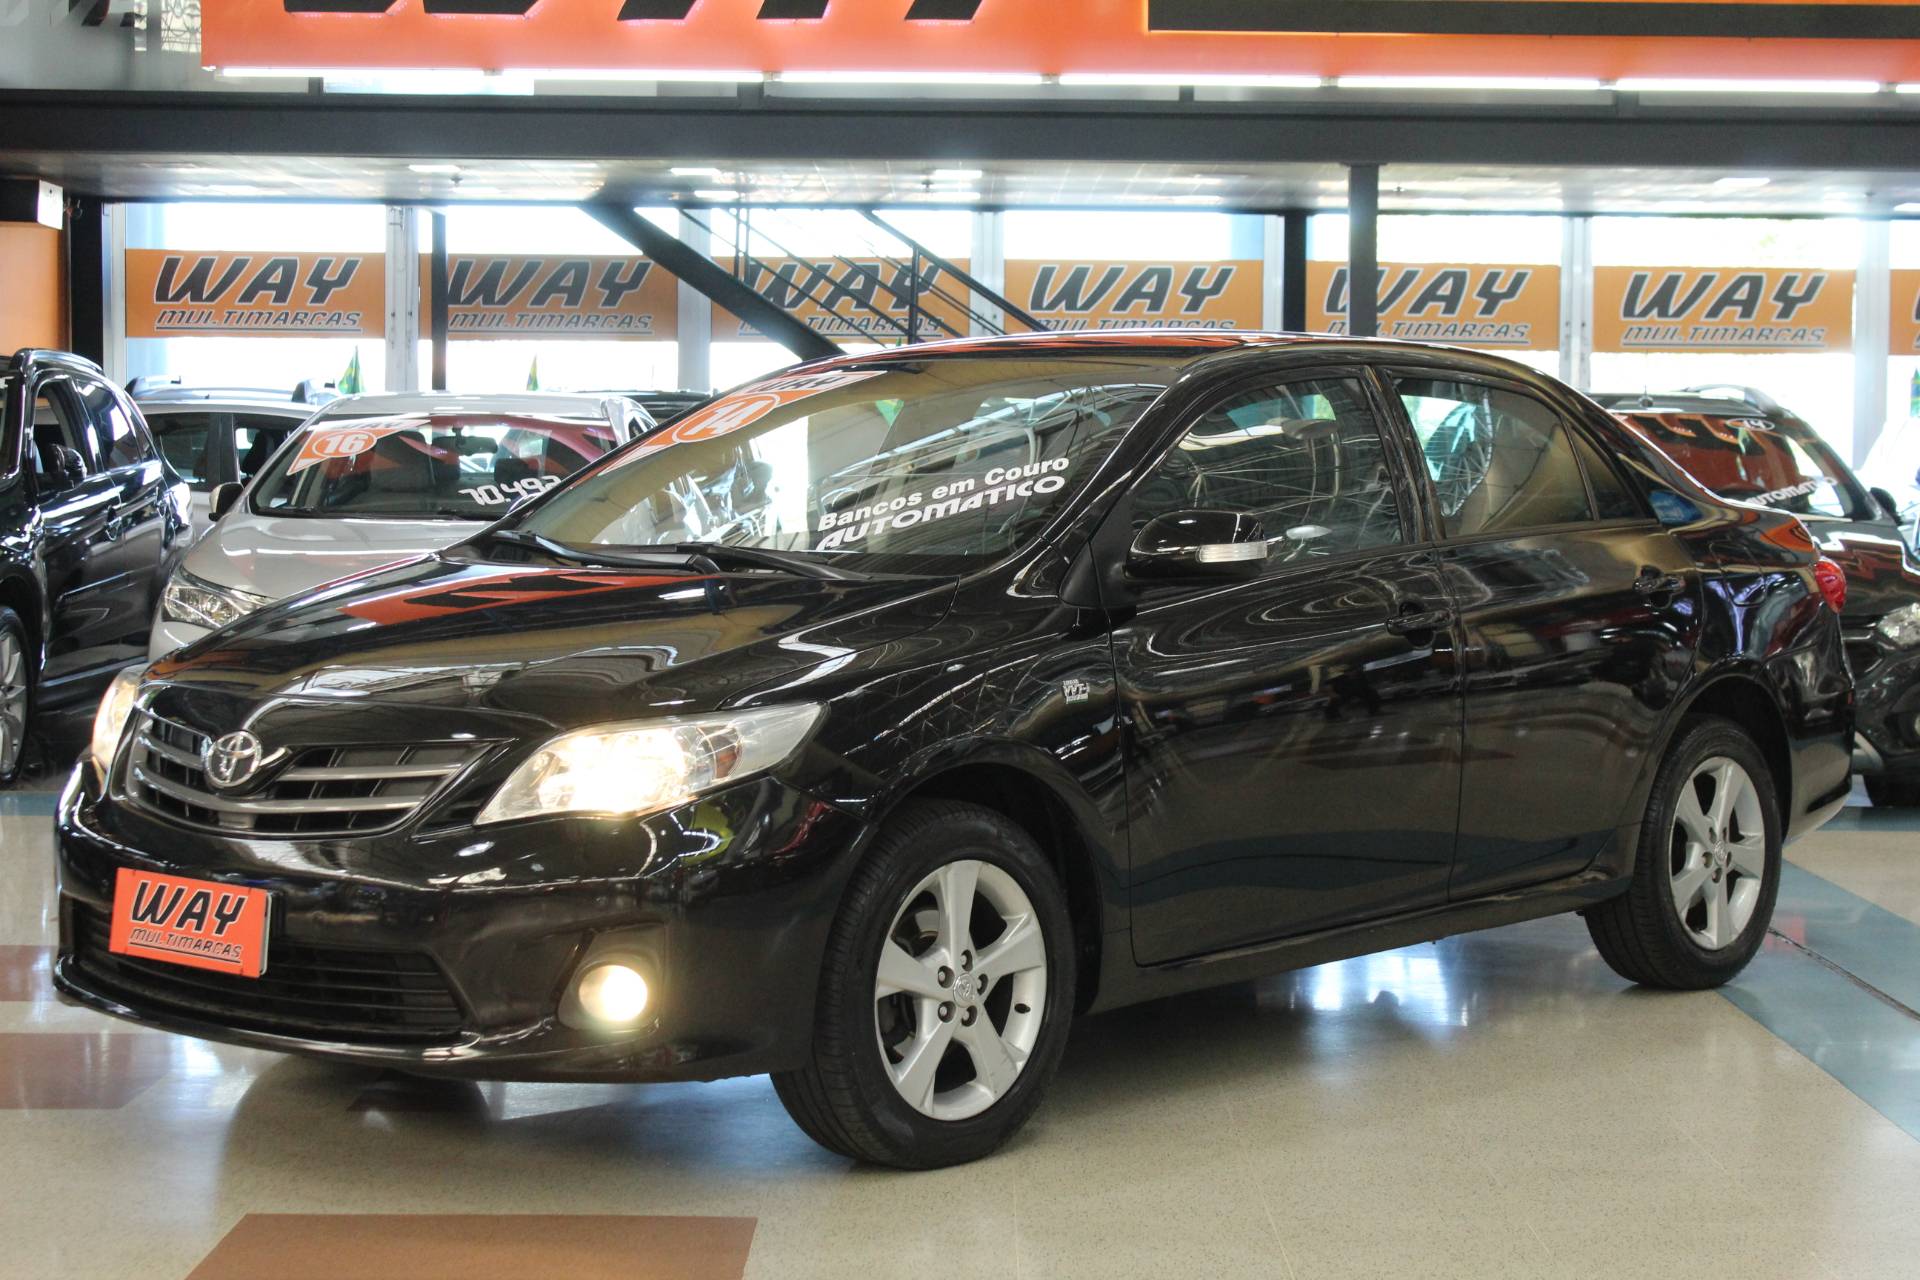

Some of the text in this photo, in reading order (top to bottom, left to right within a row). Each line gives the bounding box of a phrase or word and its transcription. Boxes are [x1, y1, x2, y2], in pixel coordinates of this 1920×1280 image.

[154, 256, 362, 305] WAY
[448, 258, 653, 308] WAY
[1029, 264, 1237, 315] WAY
[1324, 267, 1532, 317] WAY
[1621, 272, 1828, 321] WAY
[156, 309, 361, 327] MULTIMARCAS
[449, 313, 653, 330] MULTIMARCAS
[1622, 325, 1827, 343] MULTIMARCAS
[683, 399, 774, 436] 14
[322, 433, 369, 454] 16
[816, 475, 1066, 552] AUTOMATICO
[817, 457, 1070, 532] Bancos em Couro
[130, 880, 248, 937] WAY
[129, 928, 243, 958] MULTIMARCAS
